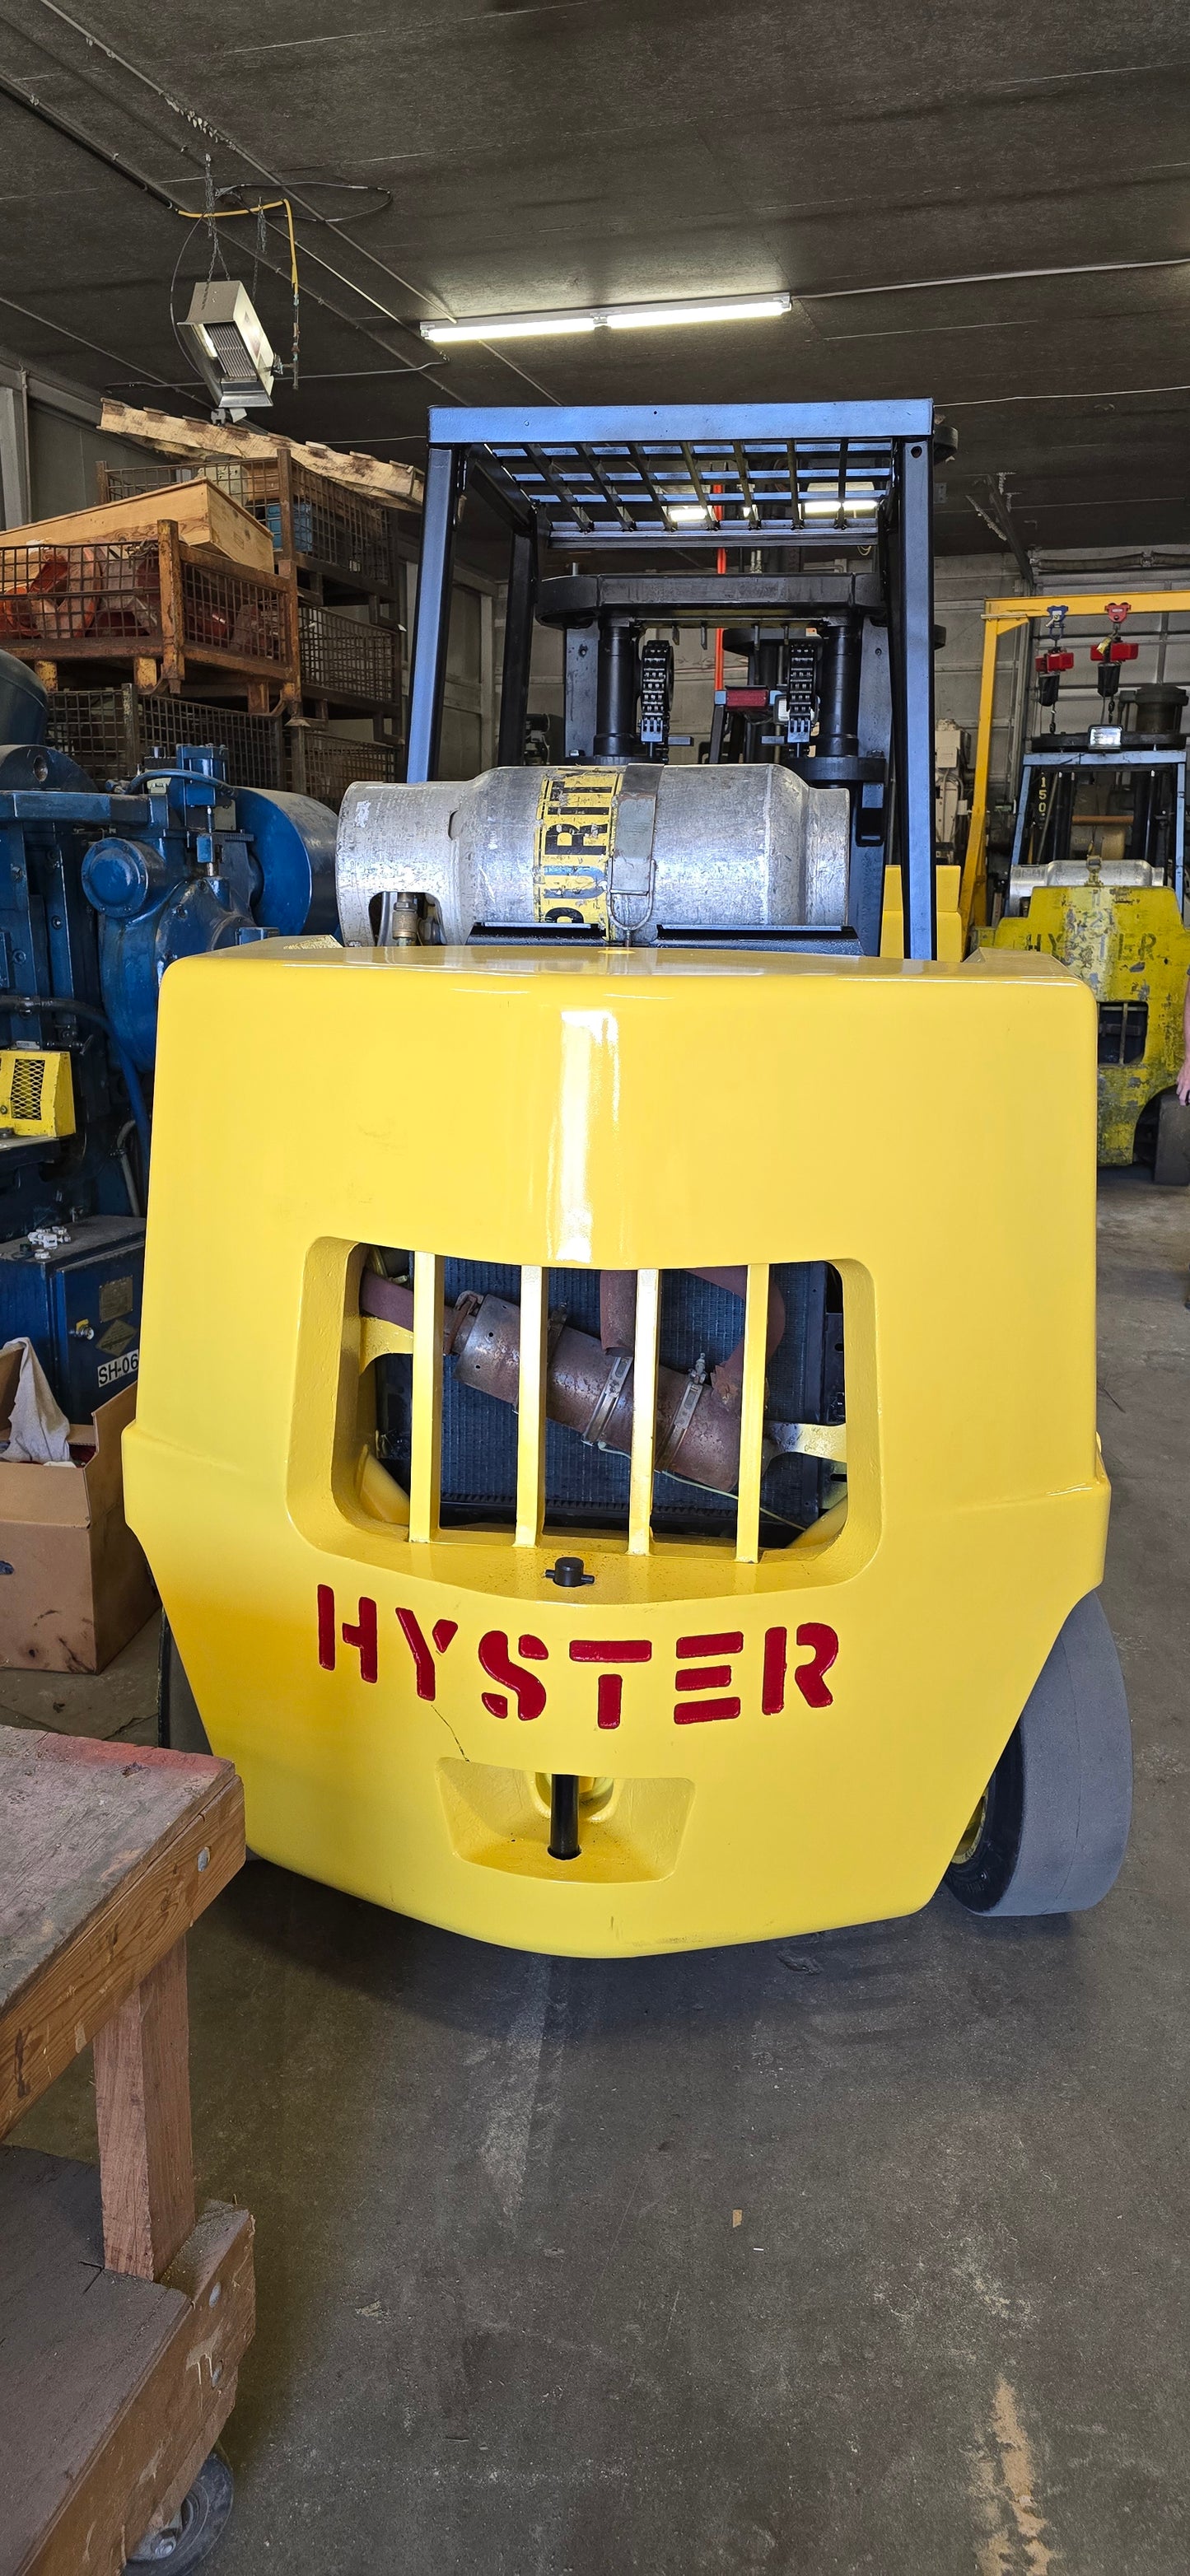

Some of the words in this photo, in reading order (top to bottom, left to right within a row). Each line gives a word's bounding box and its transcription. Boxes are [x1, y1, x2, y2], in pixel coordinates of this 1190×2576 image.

[1038, 777, 1047, 812] 150
[1026, 933, 1157, 961] HYTER
[317, 1584, 838, 1729] HYSTER
